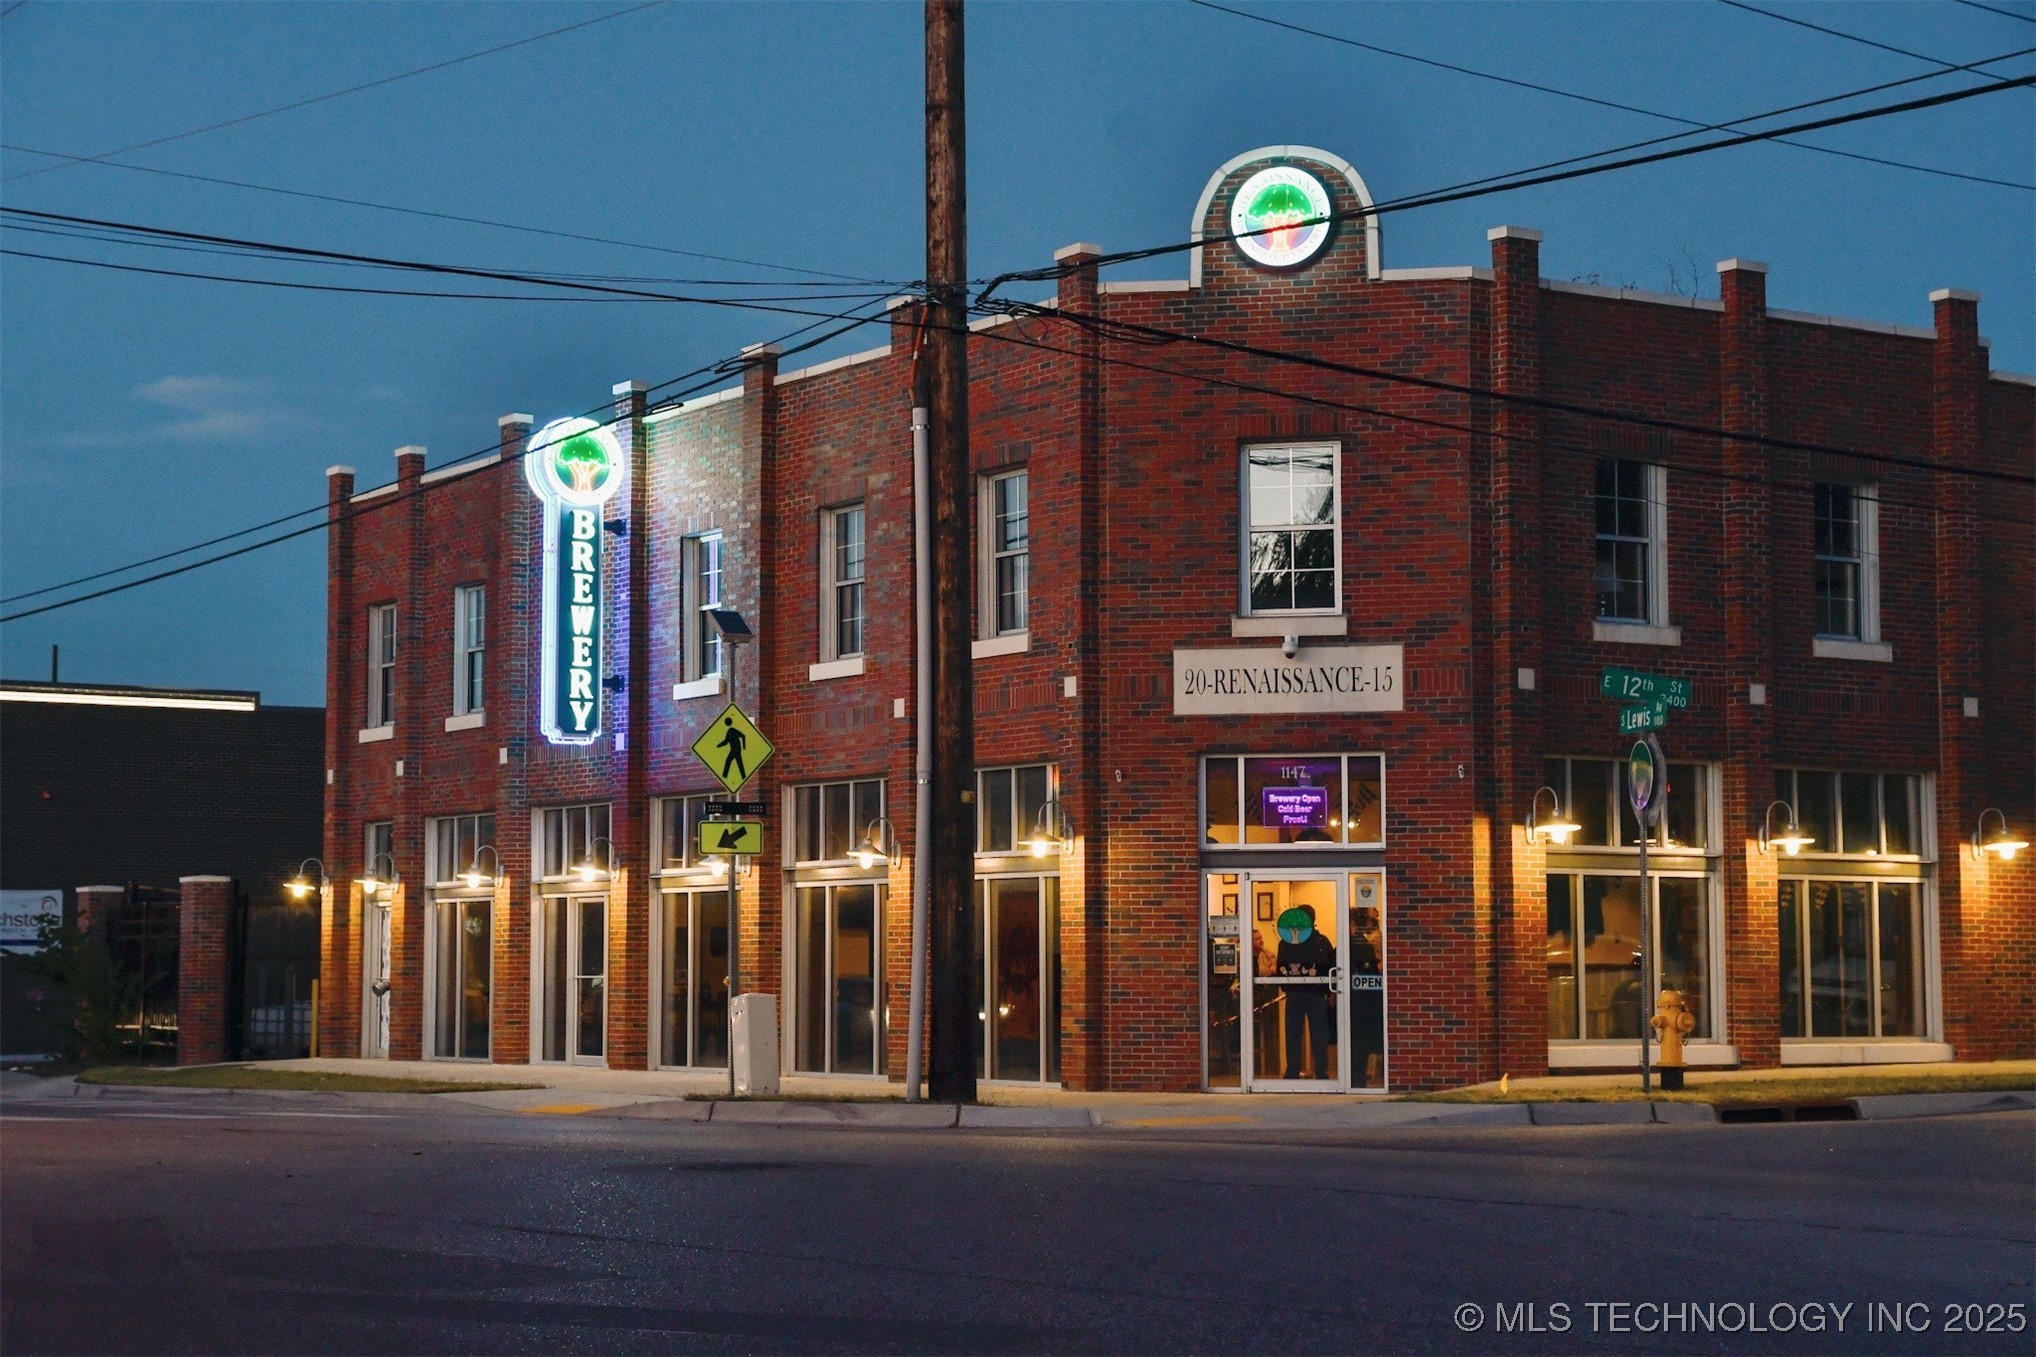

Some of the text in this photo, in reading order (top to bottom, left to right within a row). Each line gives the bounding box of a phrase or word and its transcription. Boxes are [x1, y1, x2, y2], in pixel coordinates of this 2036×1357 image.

[568, 508, 596, 732] BREWERY
[1184, 665, 1394, 696] 20-RENAISSANCE-15
[1604, 675, 1683, 698] E 12th St
[1620, 706, 1651, 730] S Lewis
[1269, 793, 1322, 805] Brewery Open
[1278, 804, 1313, 813] Cold Beer
[1353, 976, 1382, 988] OPEN
